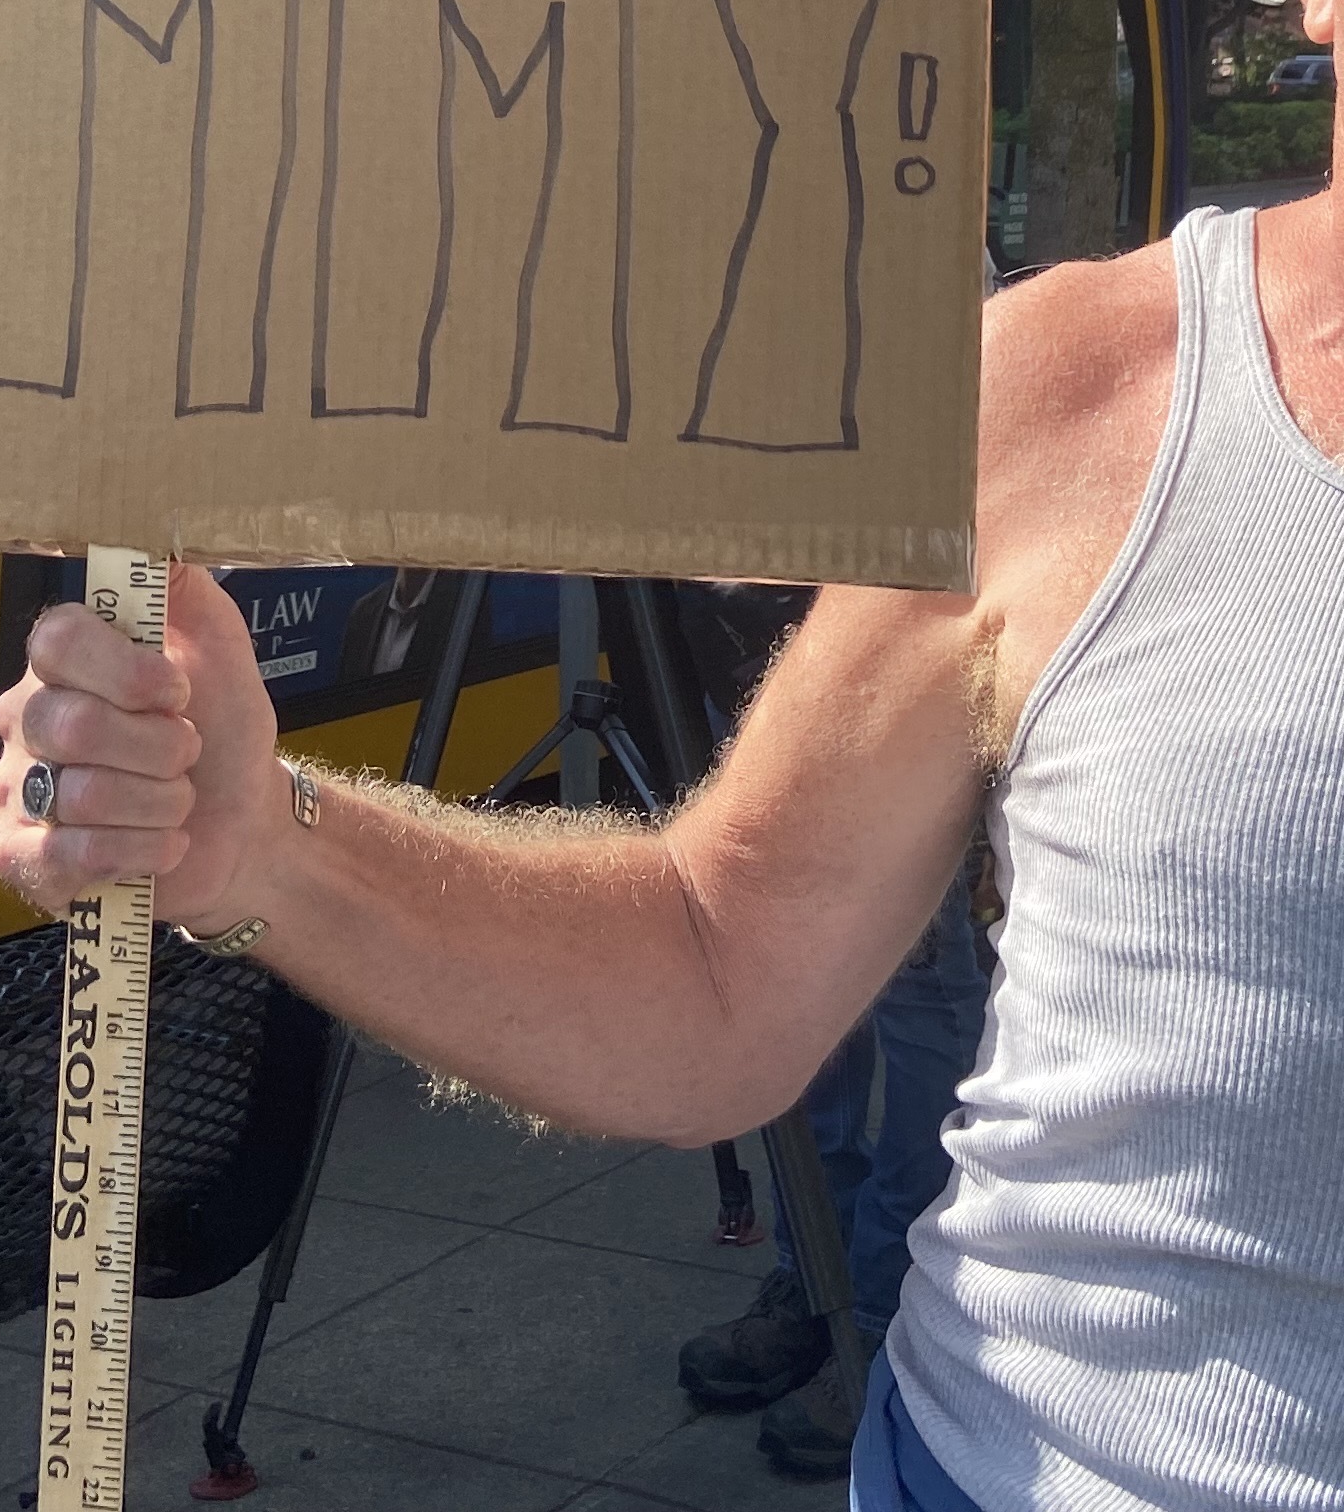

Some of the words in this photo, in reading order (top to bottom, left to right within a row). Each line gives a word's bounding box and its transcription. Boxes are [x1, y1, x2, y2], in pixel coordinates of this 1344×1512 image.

[129, 560, 148, 583] 10
[251, 587, 324, 634] LAW
[259, 654, 315, 677] ORNEYS
[110, 935, 129, 959] 15
[106, 1012, 124, 1036] 16
[53, 896, 102, 1242] HAROLD'S
[102, 1088, 120, 1113] 17
[98, 1166, 117, 1191] 18
[95, 1244, 113, 1268] 19
[91, 1320, 110, 1346] 20
[46, 1270, 80, 1480] LIGHTING
[87, 1398, 105, 1423] 21
[82, 1477, 101, 1503] 22
